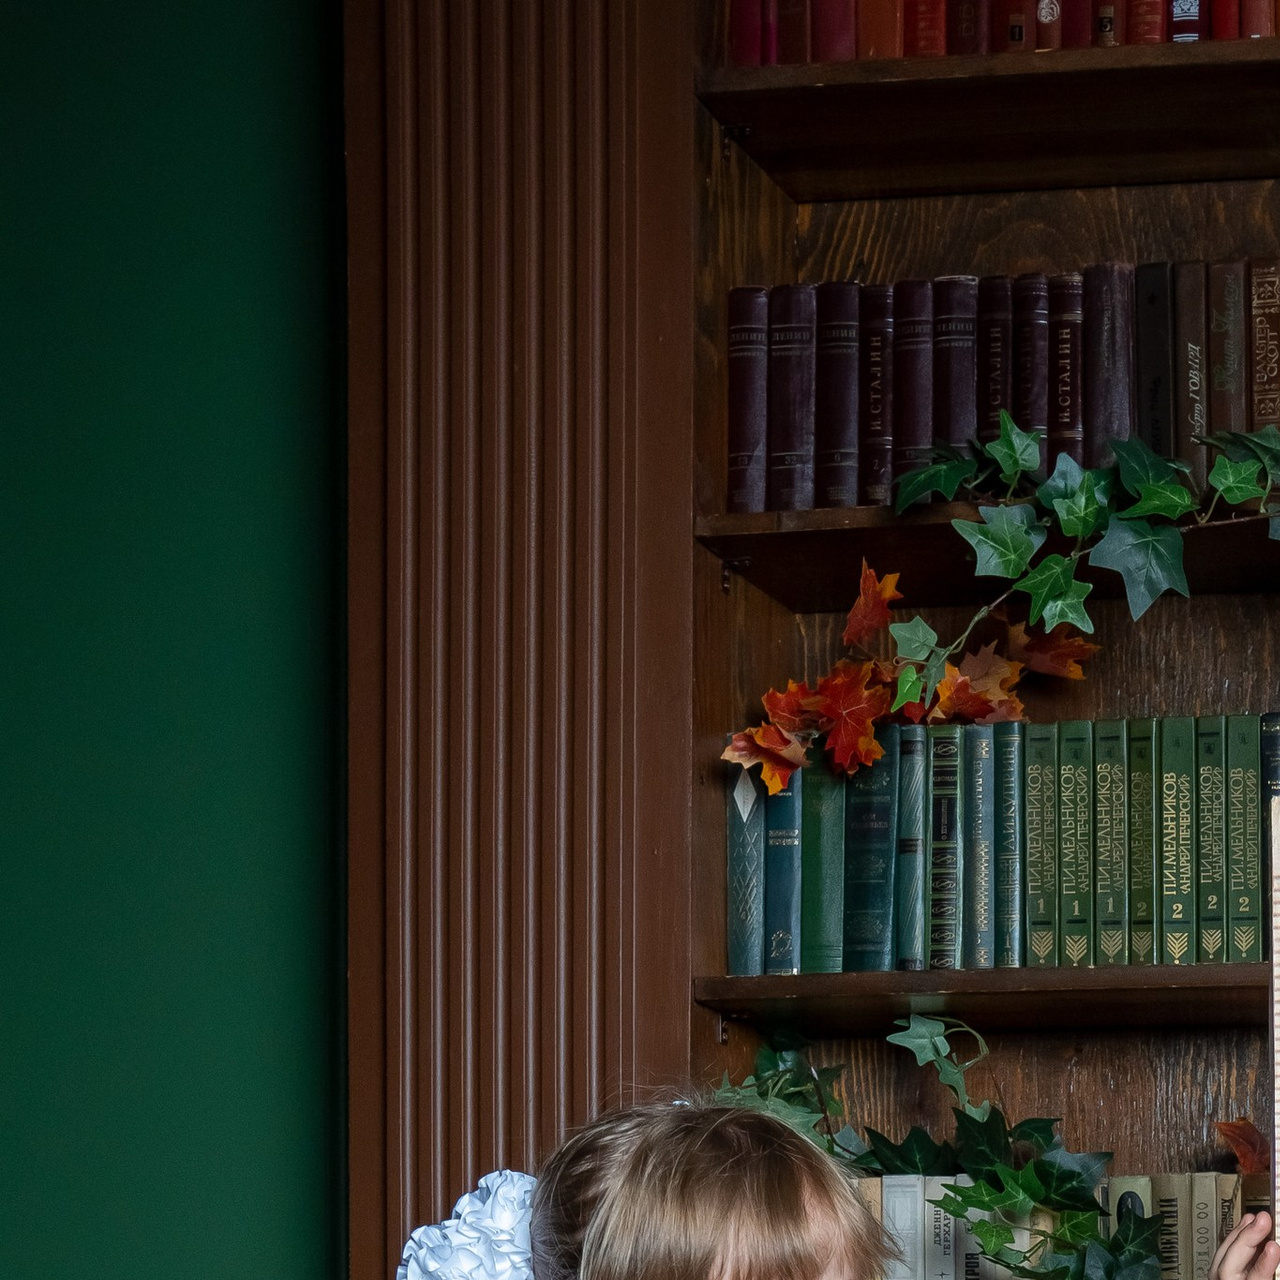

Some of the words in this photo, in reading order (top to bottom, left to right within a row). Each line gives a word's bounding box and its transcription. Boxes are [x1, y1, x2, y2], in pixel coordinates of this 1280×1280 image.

[1164, 772, 1176, 864] МЕЛЬНИКОВ
[1037, 898, 1046, 914] 1
[1072, 900, 1080, 916] 1
[1107, 897, 1115, 913] 1
[1208, 894, 1218, 910] 2
[1239, 896, 1250, 912] 2
[1172, 903, 1183, 919] 2
